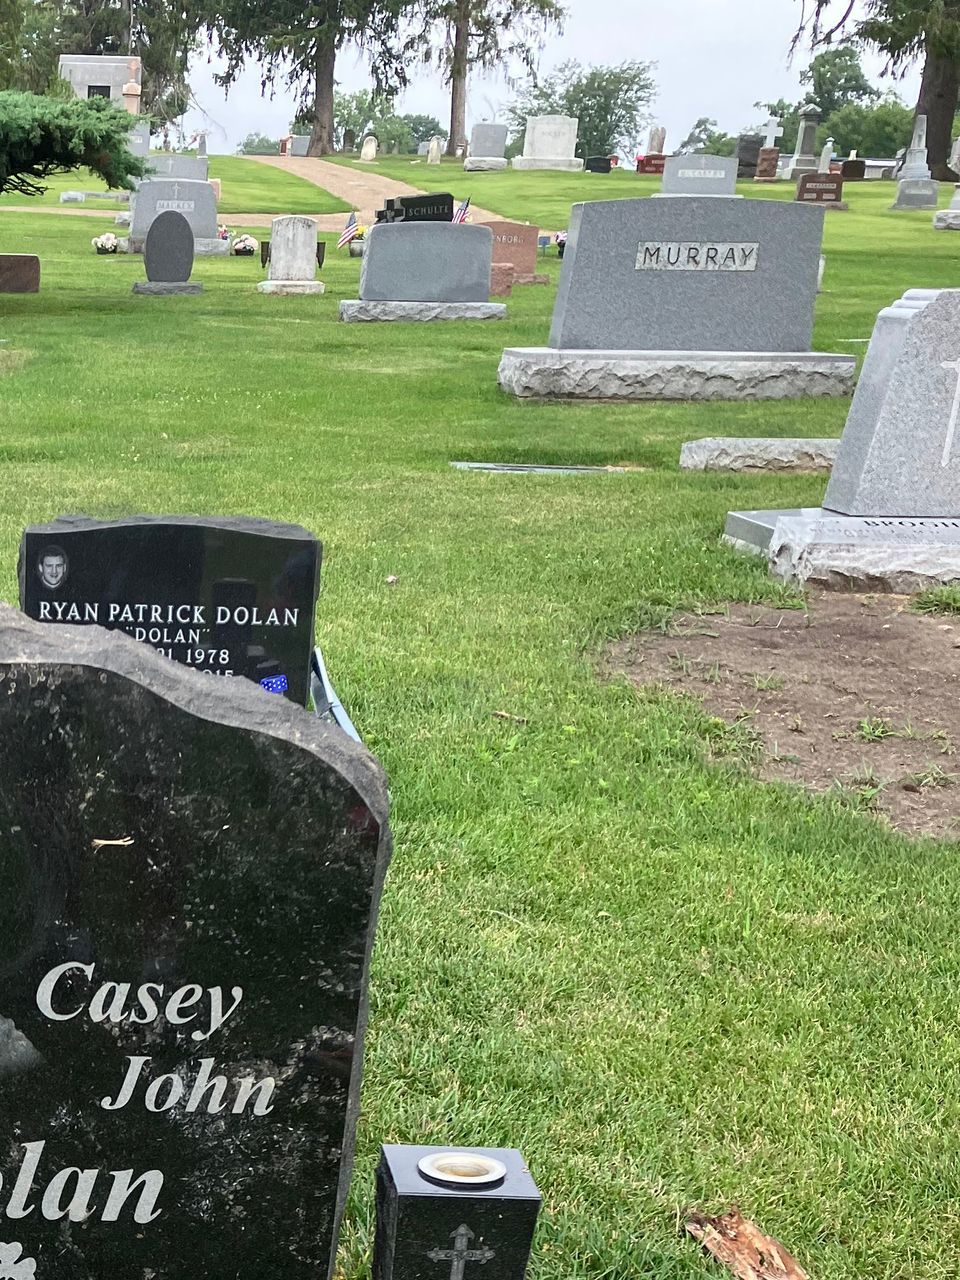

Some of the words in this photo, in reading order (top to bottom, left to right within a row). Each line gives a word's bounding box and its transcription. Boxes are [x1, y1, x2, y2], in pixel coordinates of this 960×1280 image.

[643, 247, 754, 265] MURRAY
[40, 601, 99, 622] RYAN
[109, 603, 205, 625] PATRICK
[216, 605, 299, 627] DOLAN
[126, 626, 210, 645] "DOLAN"
[186, 648, 230, 664] 1978
[36, 961, 243, 1041] Casey
[100, 1055, 276, 1116] John
